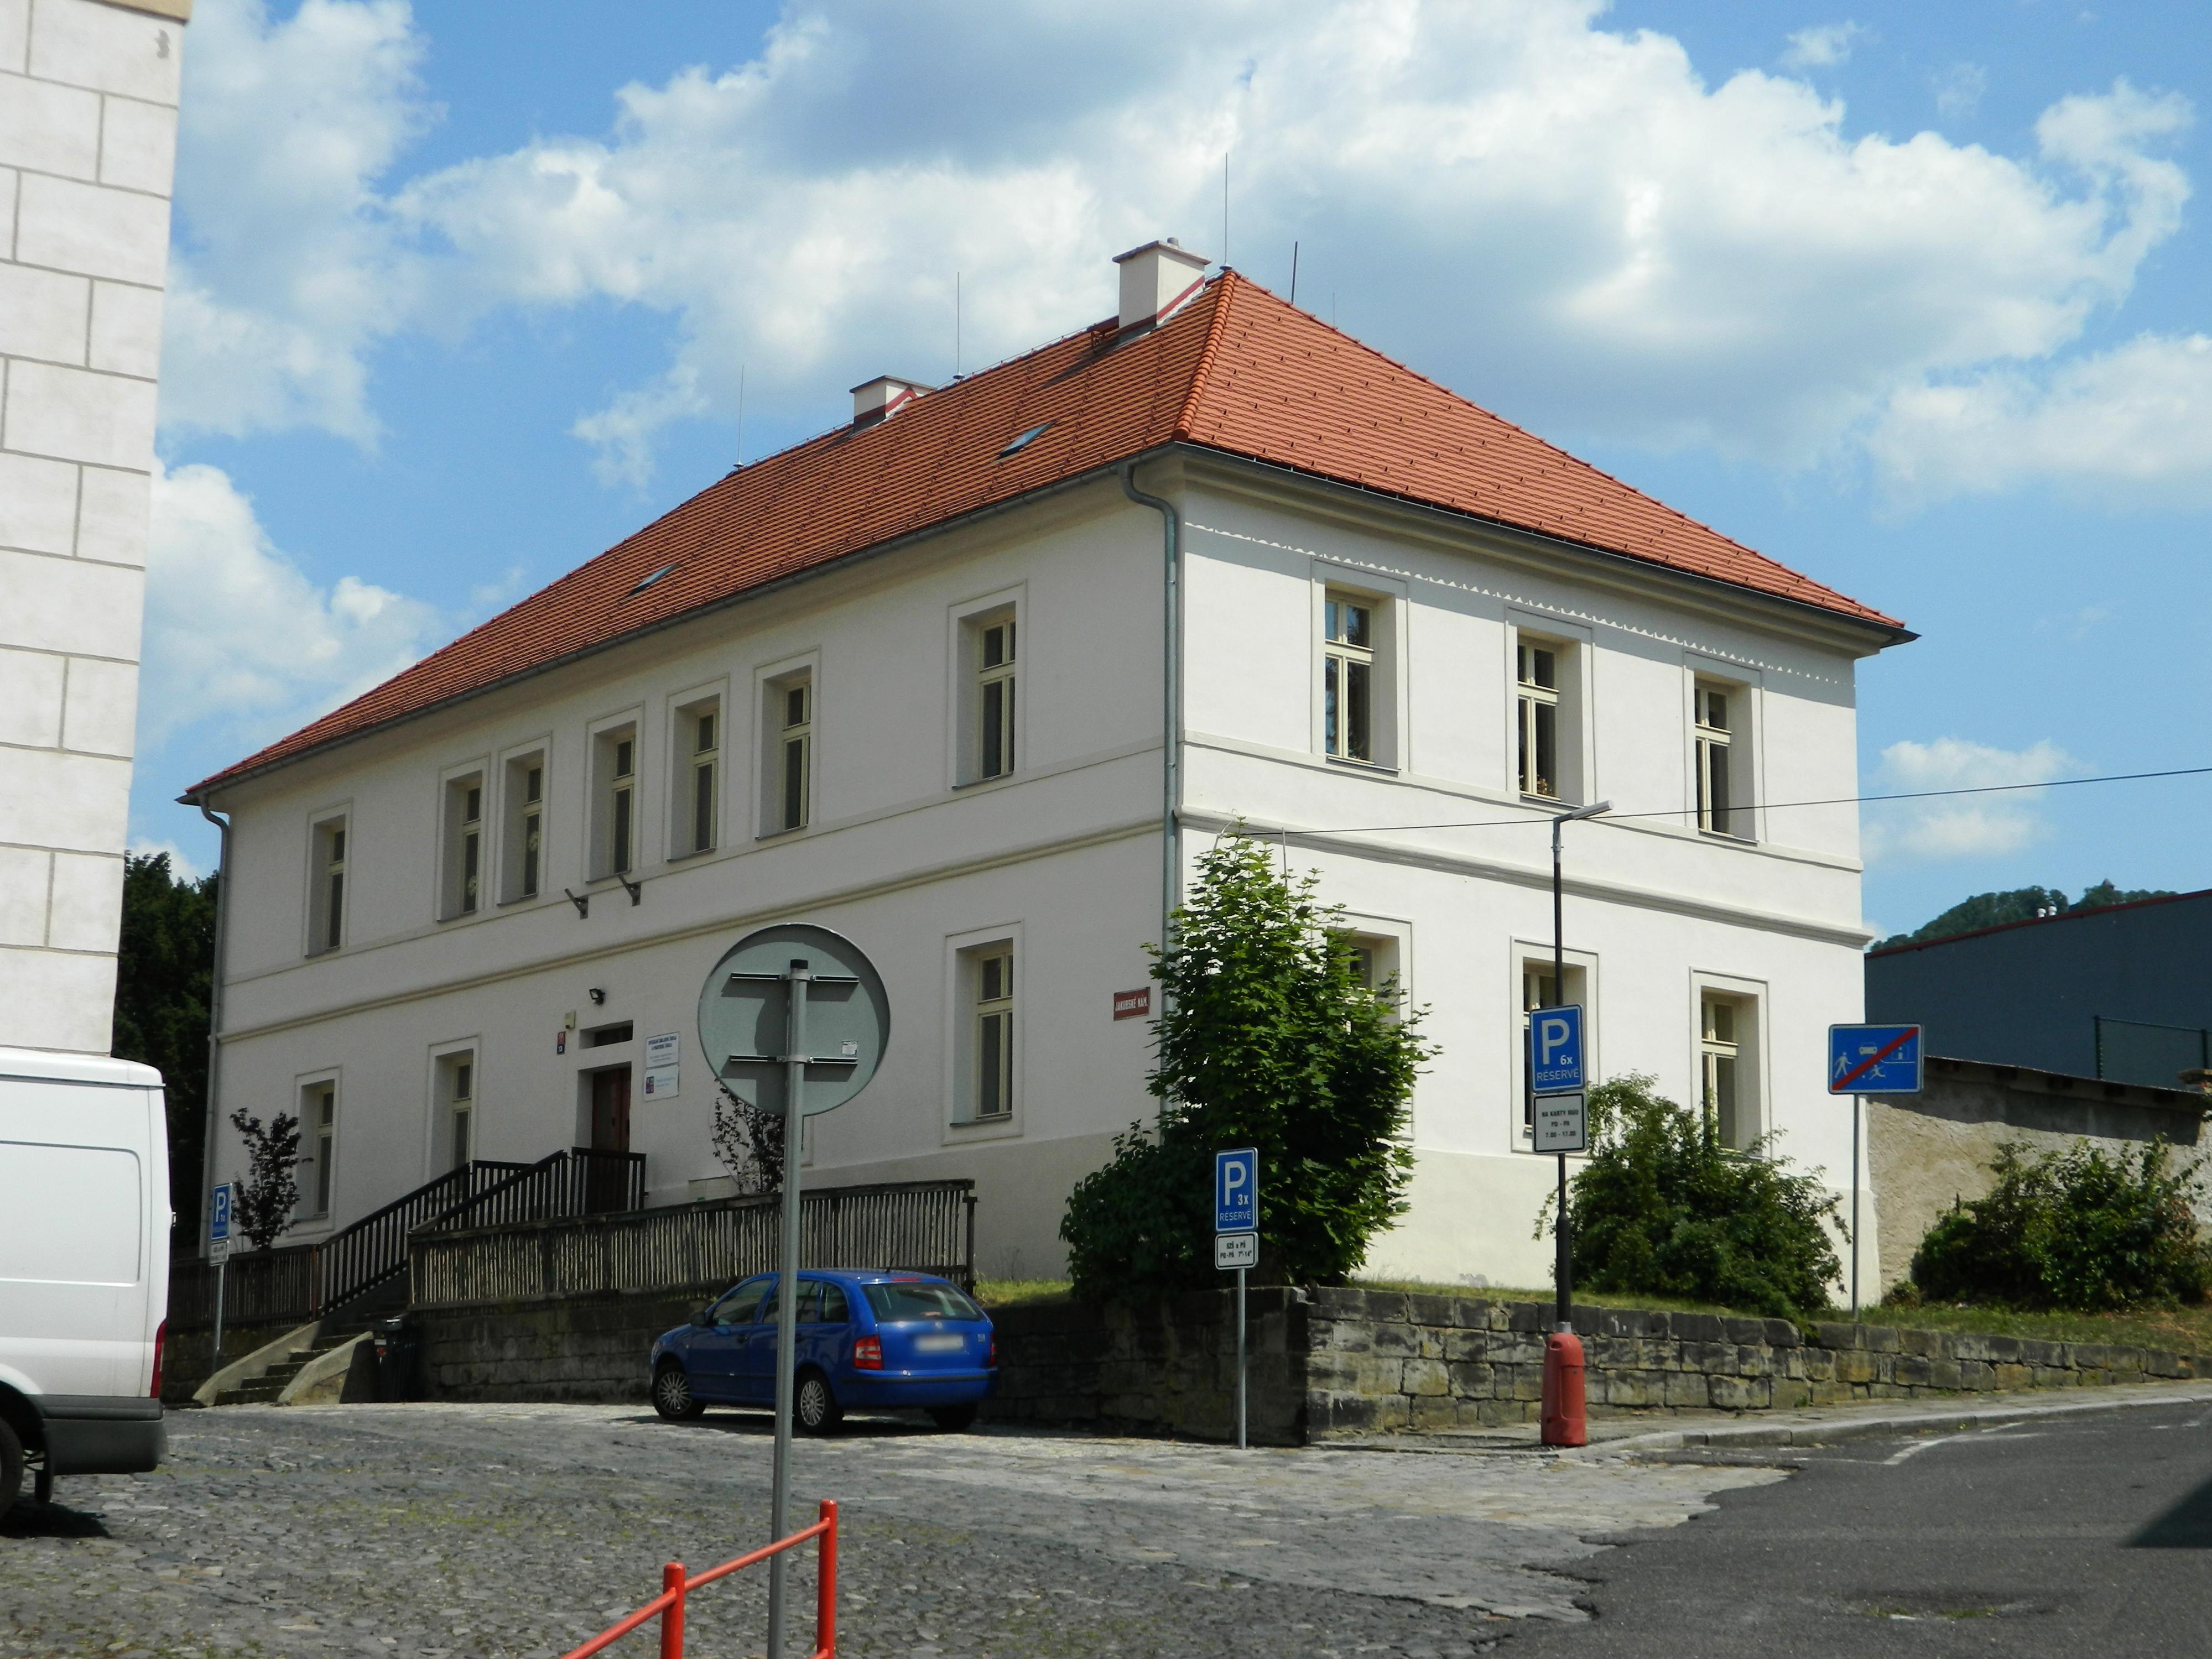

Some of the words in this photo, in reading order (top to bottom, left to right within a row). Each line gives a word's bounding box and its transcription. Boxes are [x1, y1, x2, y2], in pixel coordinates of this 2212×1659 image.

[1542, 1018, 1570, 1065] P
[1560, 1055, 1573, 1065] 6x
[1537, 1067, 1580, 1082] RÉSERVÉ
[1224, 1161, 1247, 1206] P
[1238, 1193, 1249, 1206] 3x
[215, 1192, 226, 1223] P
[1219, 1209, 1251, 1222] RÉSERVÉ
